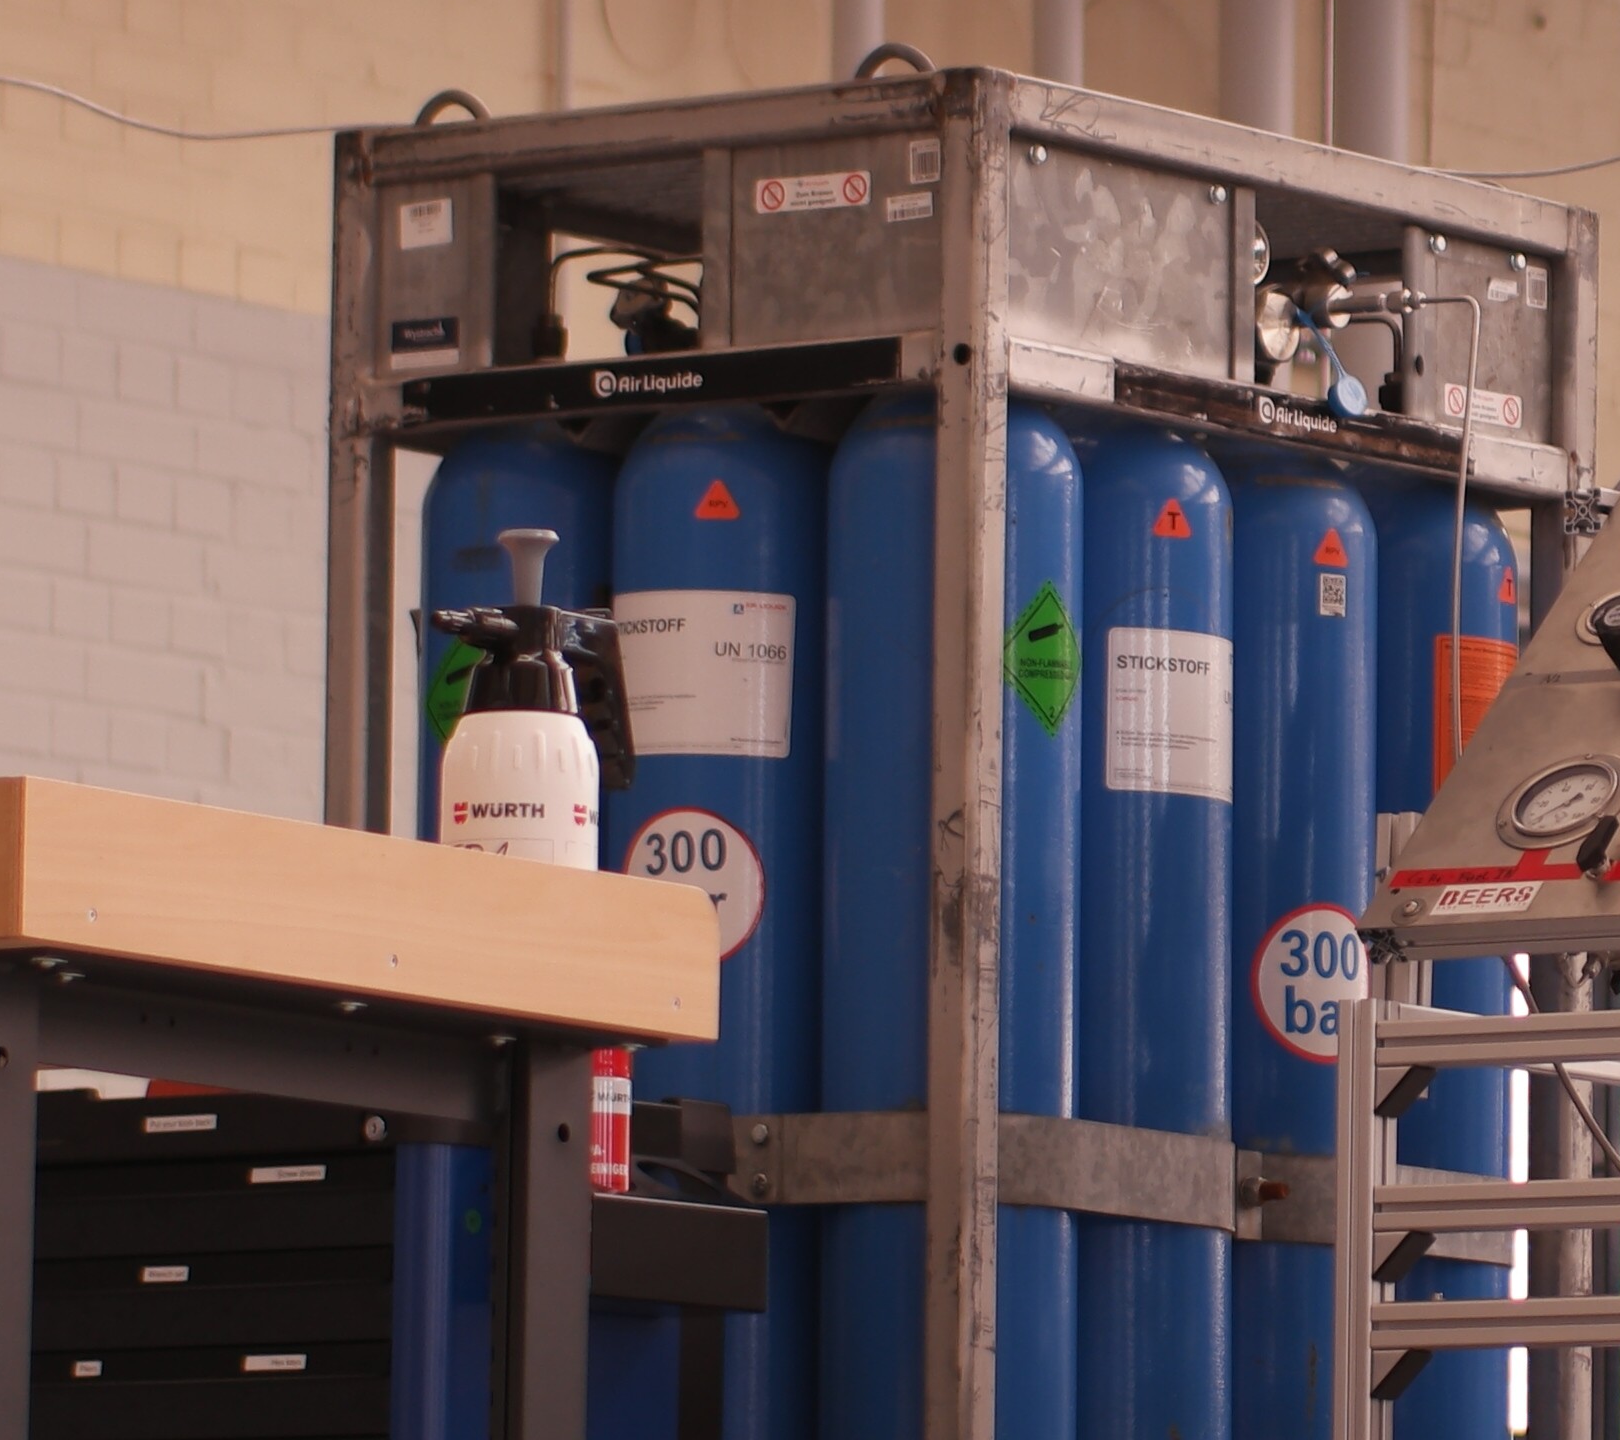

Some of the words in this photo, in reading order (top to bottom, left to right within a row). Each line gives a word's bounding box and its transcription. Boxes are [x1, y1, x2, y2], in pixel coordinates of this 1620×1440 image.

[1167, 511, 1181, 531] T
[714, 641, 742, 658] UN
[747, 643, 787, 661] 1066
[1116, 654, 1211, 677] STICKSTOFF
[471, 802, 546, 820] WÜRTH
[645, 828, 727, 876] 300
[1438, 887, 1534, 907] BEERS
[1280, 929, 1359, 981] 300
[1285, 985, 1339, 1035] ba
